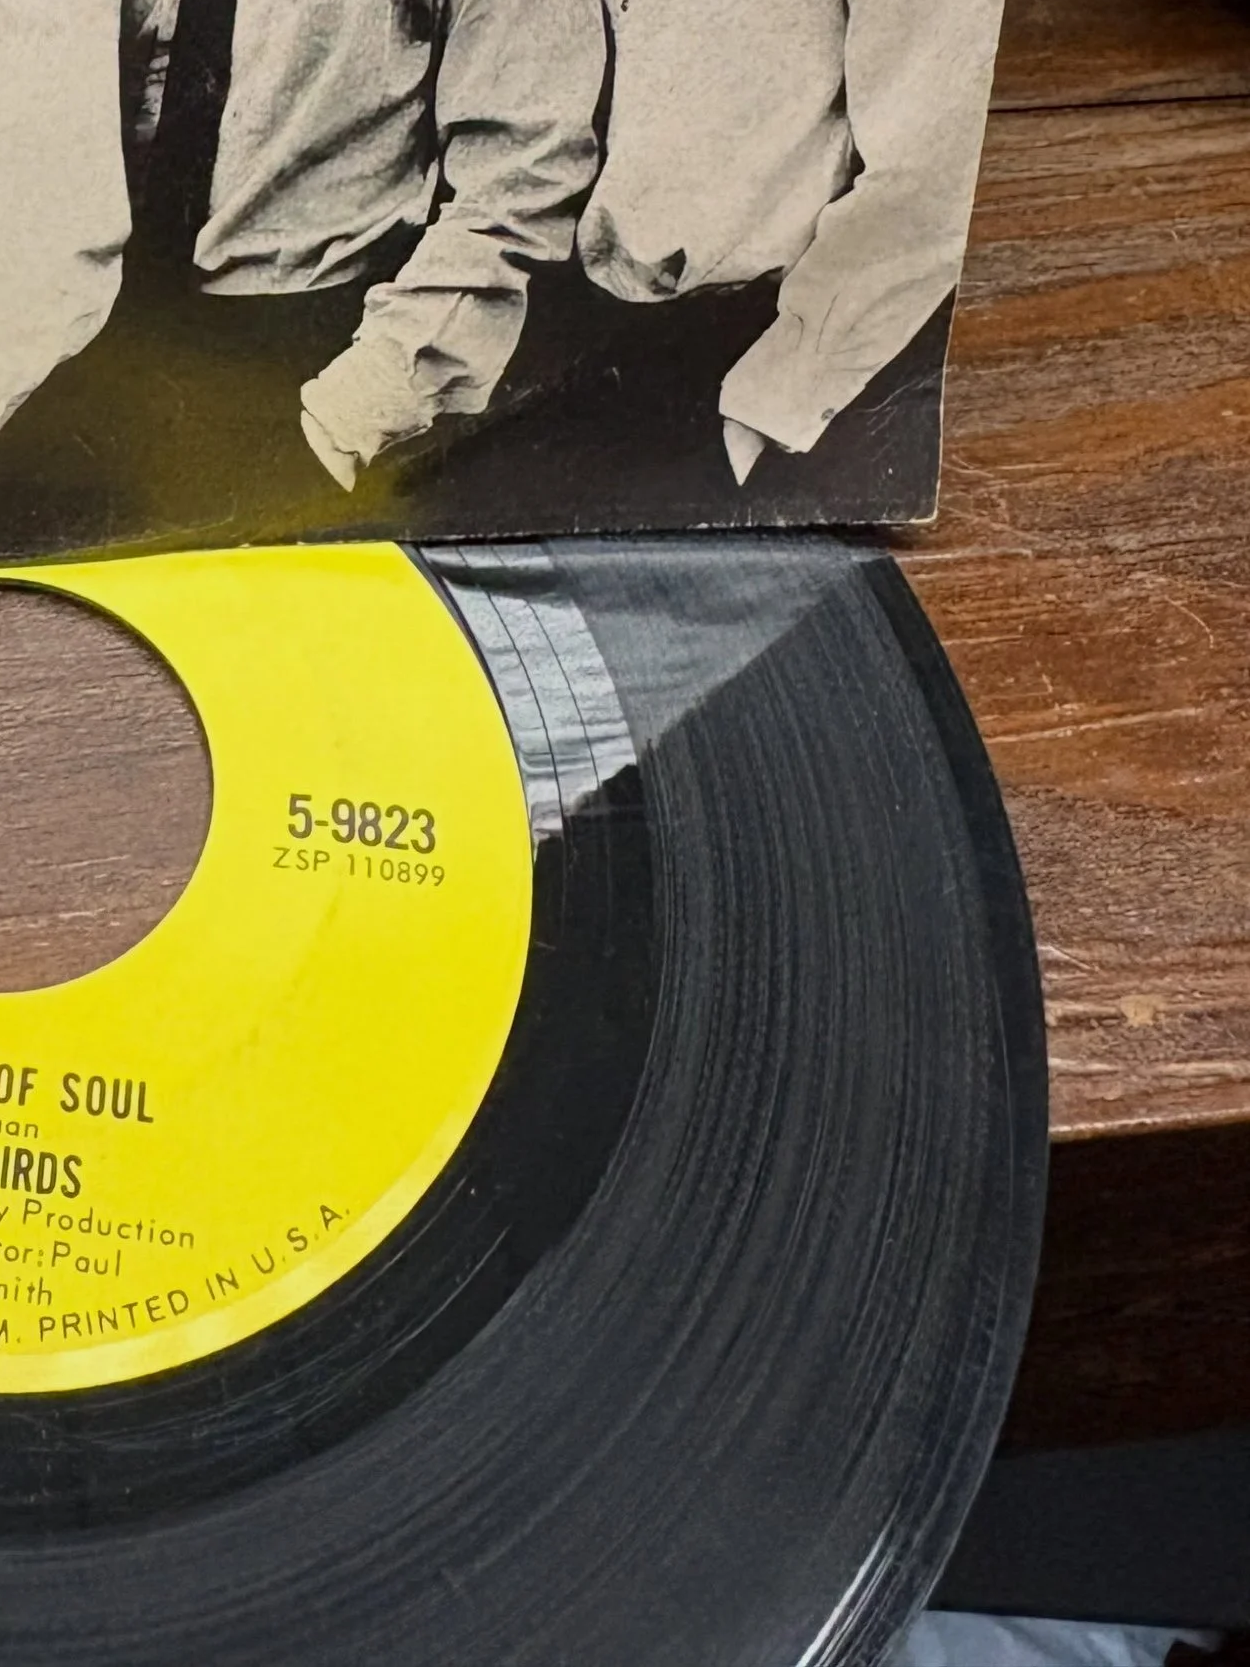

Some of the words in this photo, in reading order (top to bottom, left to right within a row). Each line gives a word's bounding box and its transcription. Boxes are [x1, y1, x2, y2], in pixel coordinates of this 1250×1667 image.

[287, 792, 437, 854] 5-9823
[272, 846, 331, 873] ZSP
[346, 852, 446, 887] 110899
[60, 1072, 154, 1124] SOUL
[22, 1198, 195, 1249] Production
[51, 1240, 122, 1277] Paul
[38, 1289, 190, 1343] PRINTED
[205, 1266, 241, 1301] IN
